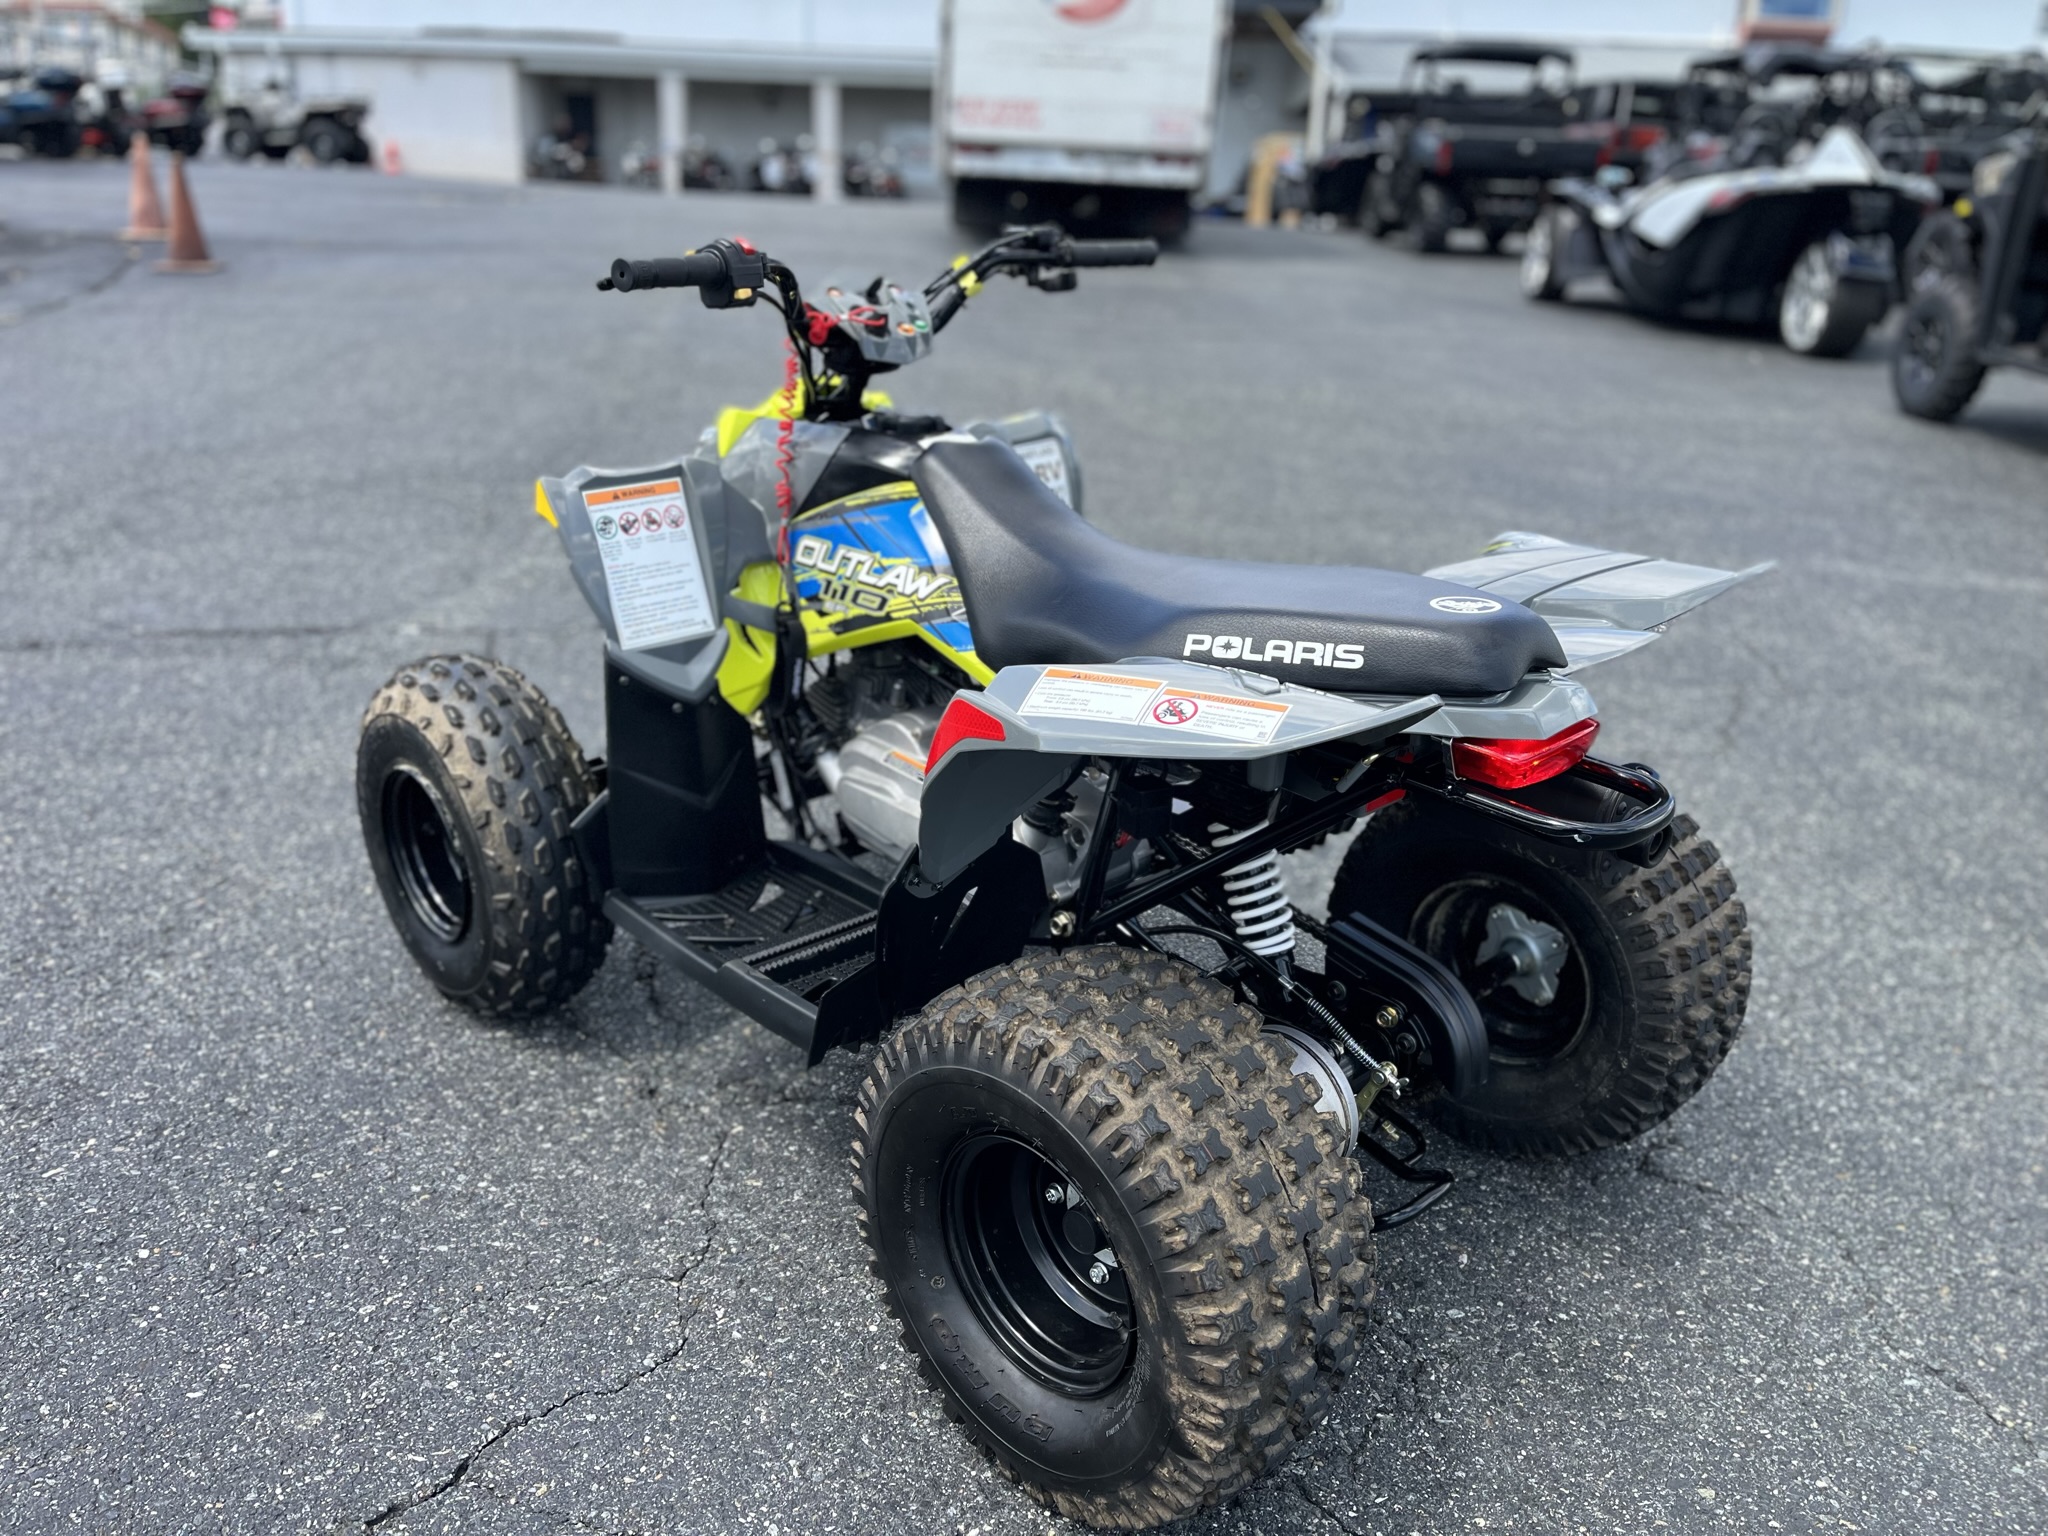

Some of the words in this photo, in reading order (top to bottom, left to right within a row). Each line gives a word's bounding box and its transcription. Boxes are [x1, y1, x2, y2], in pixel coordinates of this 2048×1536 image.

[621, 486, 656, 499] WARNING
[795, 537, 953, 600] OUTLAW
[820, 577, 889, 614] 110
[1183, 633, 1365, 670] POLARIS
[1083, 673, 1134, 685] WARNING
[1202, 694, 1256, 707] WARNING
